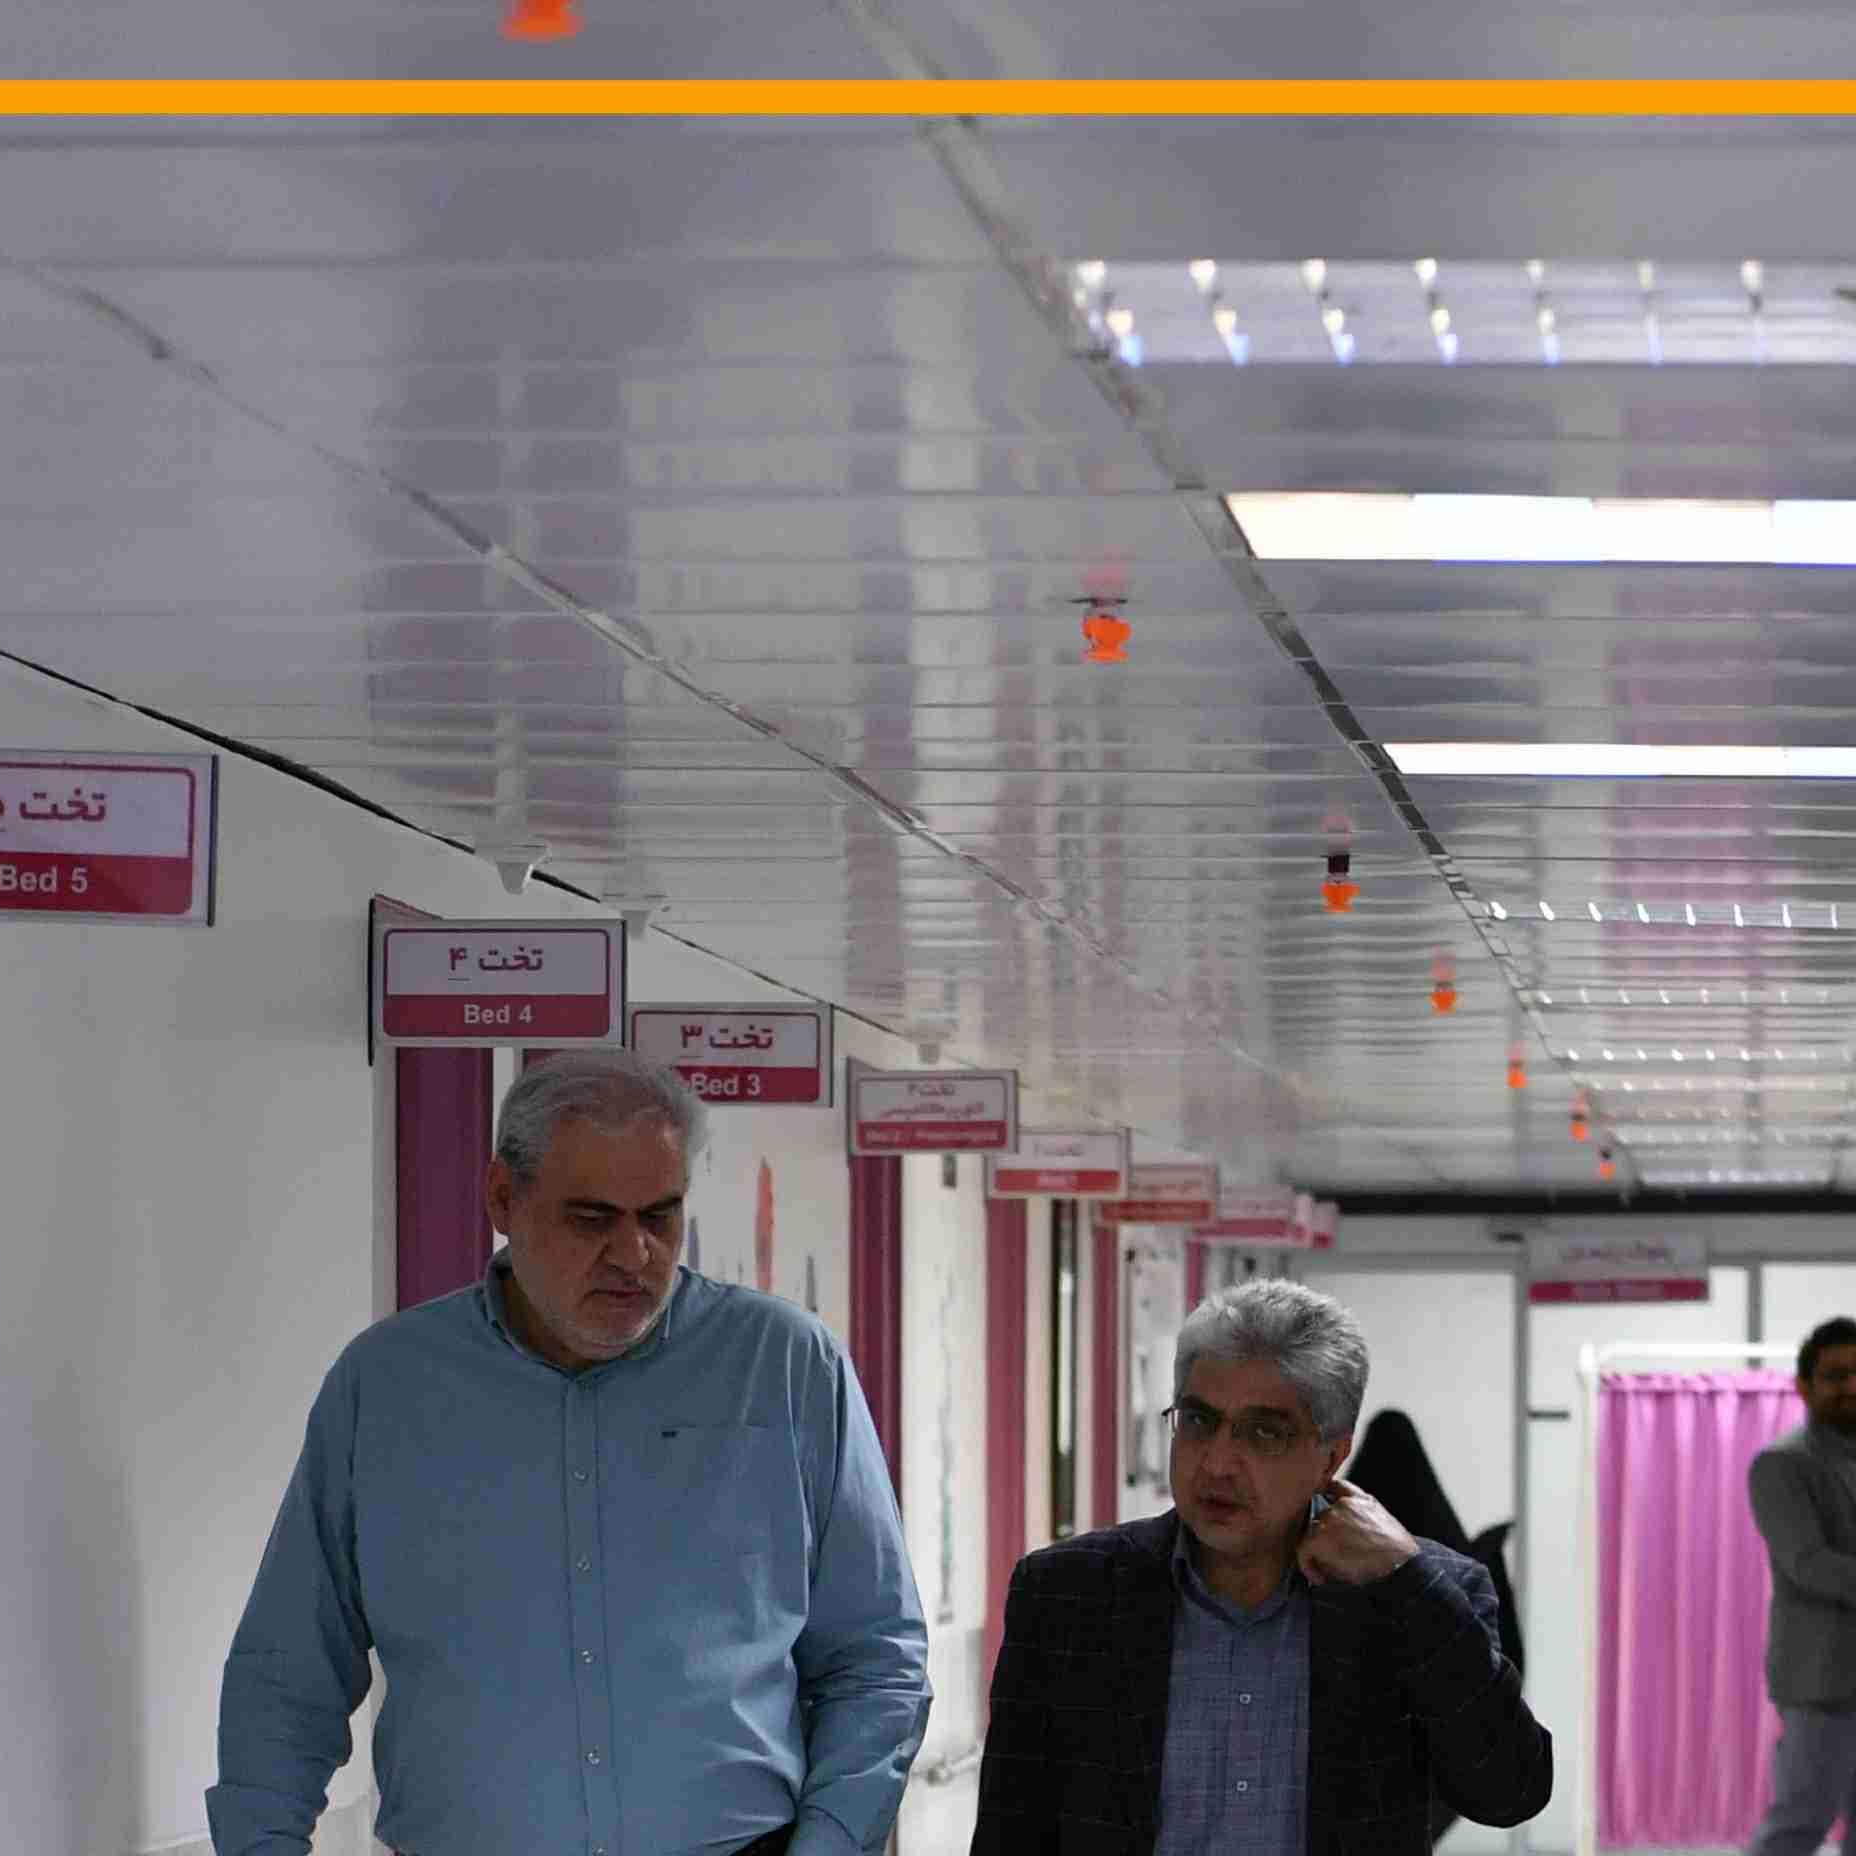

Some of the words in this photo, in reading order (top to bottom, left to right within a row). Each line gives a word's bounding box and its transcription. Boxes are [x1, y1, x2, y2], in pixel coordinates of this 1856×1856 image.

[18, 788, 108, 823] تخت
[70, 866, 89, 894] 5
[448, 945, 468, 972] ۴
[477, 945, 545, 972] تخت
[463, 1003, 512, 1025] Bed
[516, 1004, 534, 1024] 4
[679, 1024, 703, 1049] ۳
[708, 1023, 775, 1051] تخت
[693, 1072, 739, 1097] Bed
[747, 1073, 763, 1097] 3
